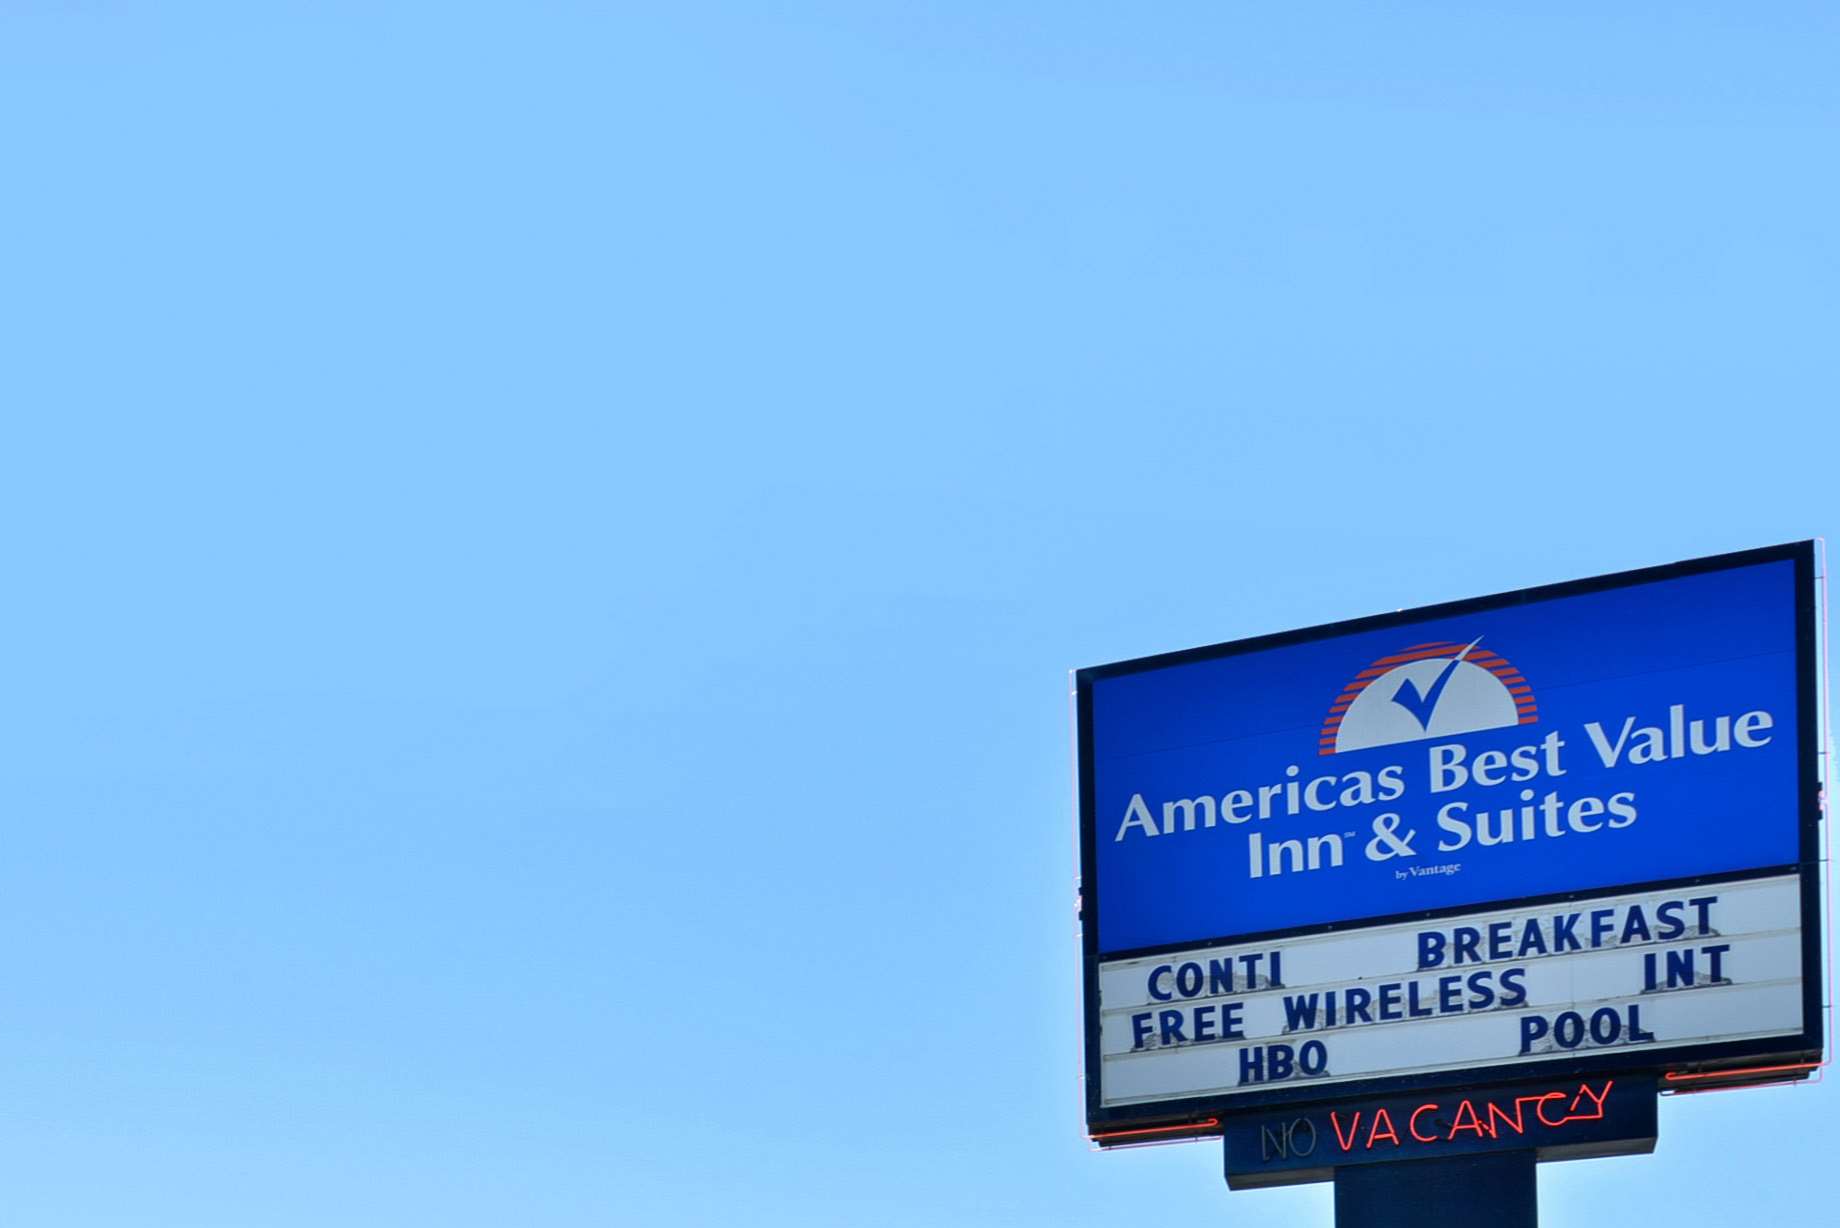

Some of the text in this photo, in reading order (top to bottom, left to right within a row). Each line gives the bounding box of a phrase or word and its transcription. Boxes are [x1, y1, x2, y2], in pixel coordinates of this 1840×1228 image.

[1114, 703, 1774, 842] Americas Best Value
[1364, 812, 1417, 862] &
[1436, 788, 1638, 852] Suites
[1395, 862, 1462, 880] by Vantage
[1147, 896, 1718, 1001] CONTI BREAKFAST
[1131, 944, 1730, 1050] FREE WIRELESS INT
[1238, 1004, 1655, 1085] HBO POOL
[1261, 1080, 1614, 1161] NO VACANCY
